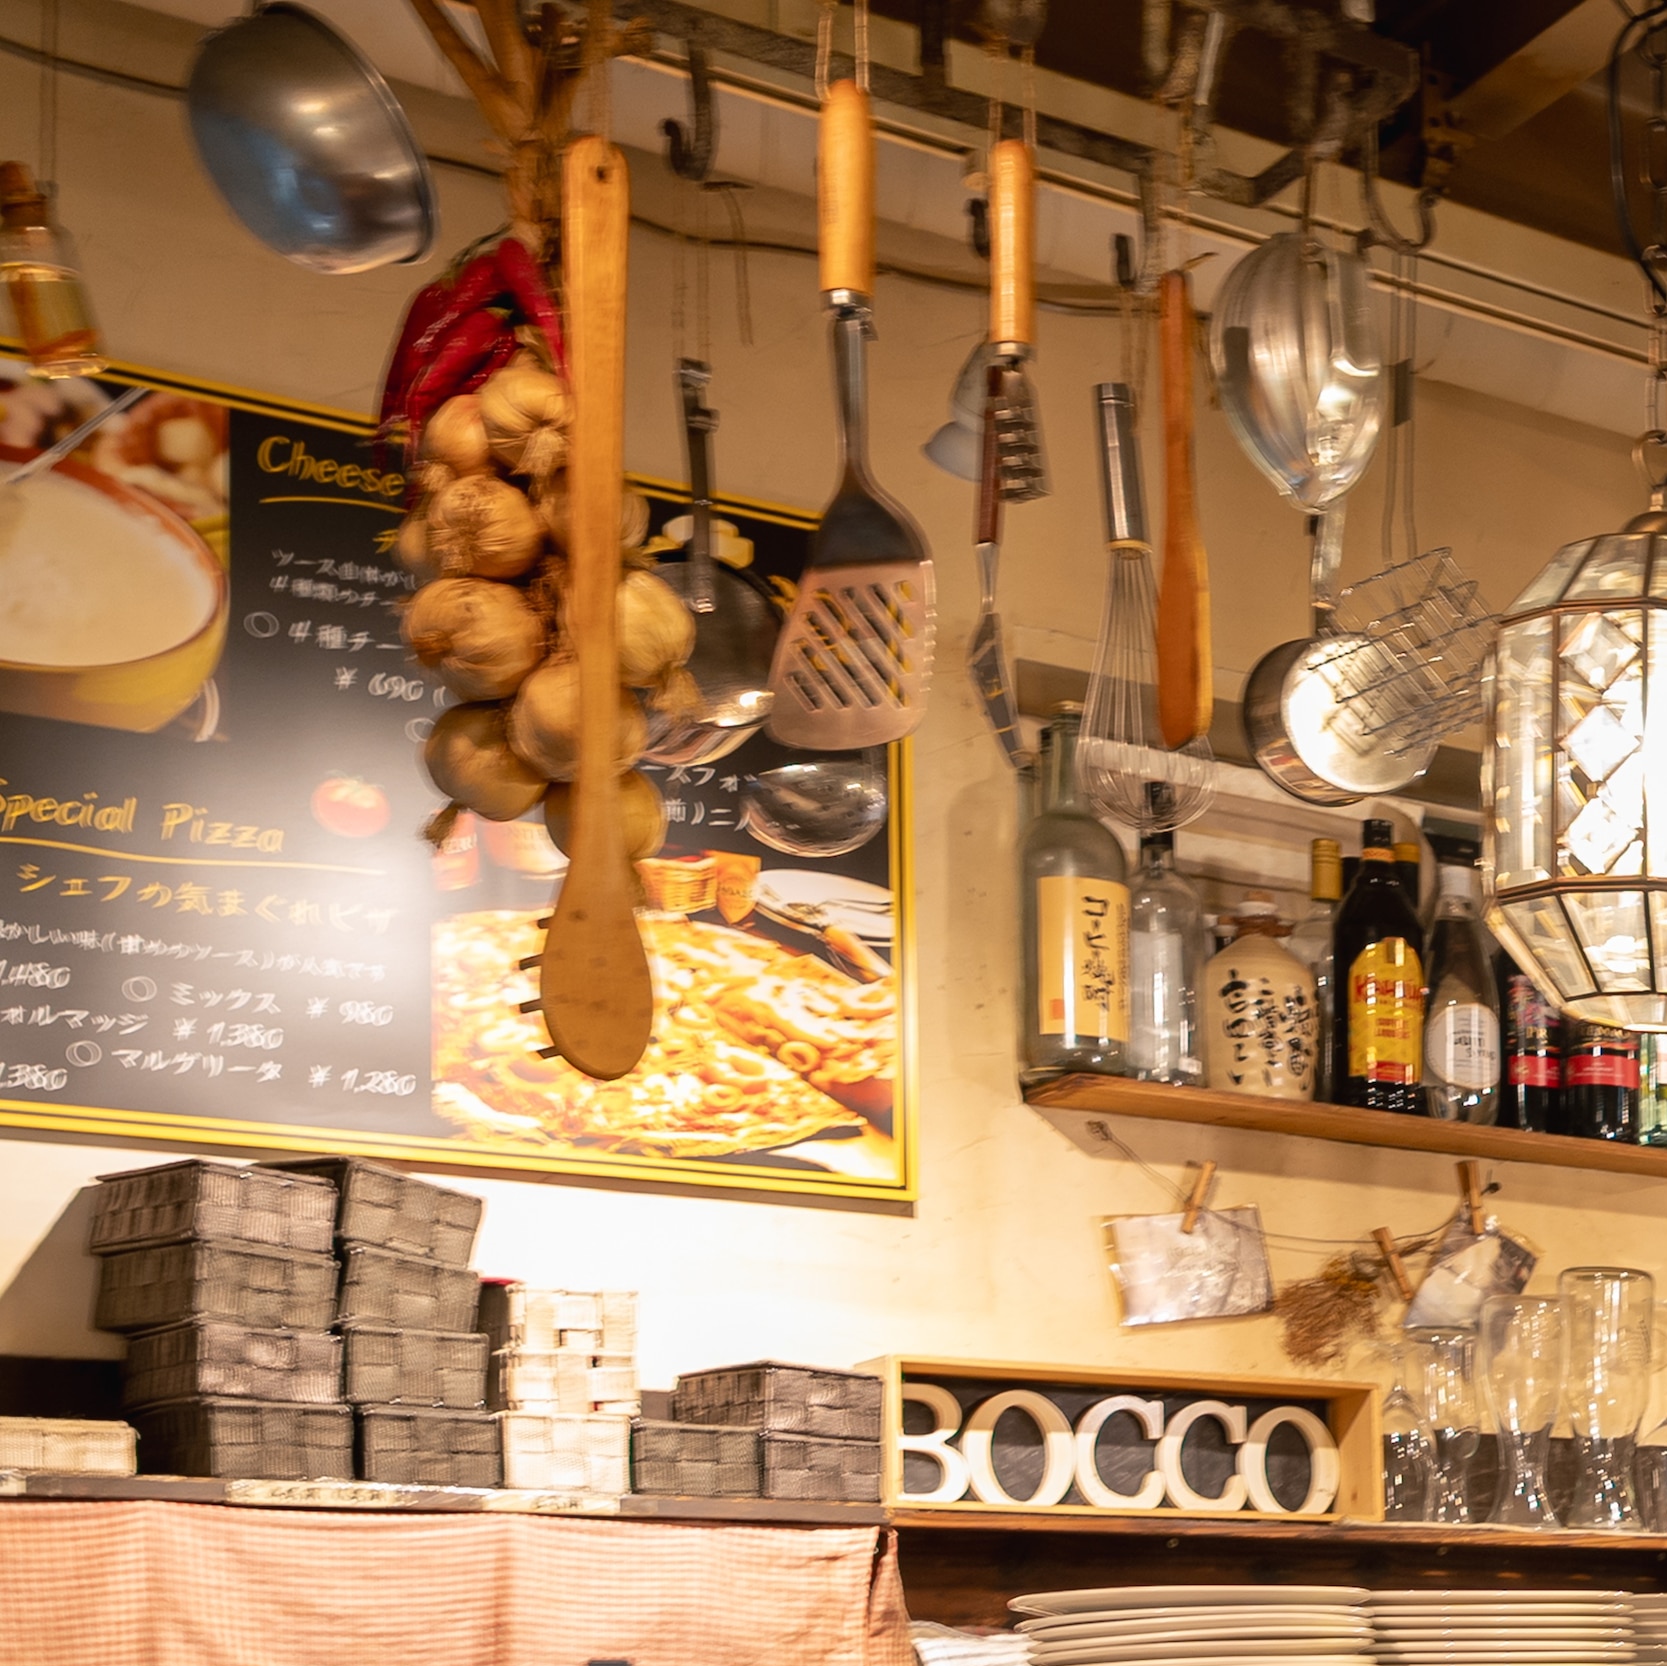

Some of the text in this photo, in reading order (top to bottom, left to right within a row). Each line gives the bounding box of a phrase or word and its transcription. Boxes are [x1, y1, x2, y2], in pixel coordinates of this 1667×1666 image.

[257, 436, 405, 496] Cheese
[159, 803, 285, 852] Pizza
[168, 981, 281, 1015] ミックス
[111, 1048, 283, 1084] マルゲリータ
[900, 1384, 1340, 1514] BOCCO
